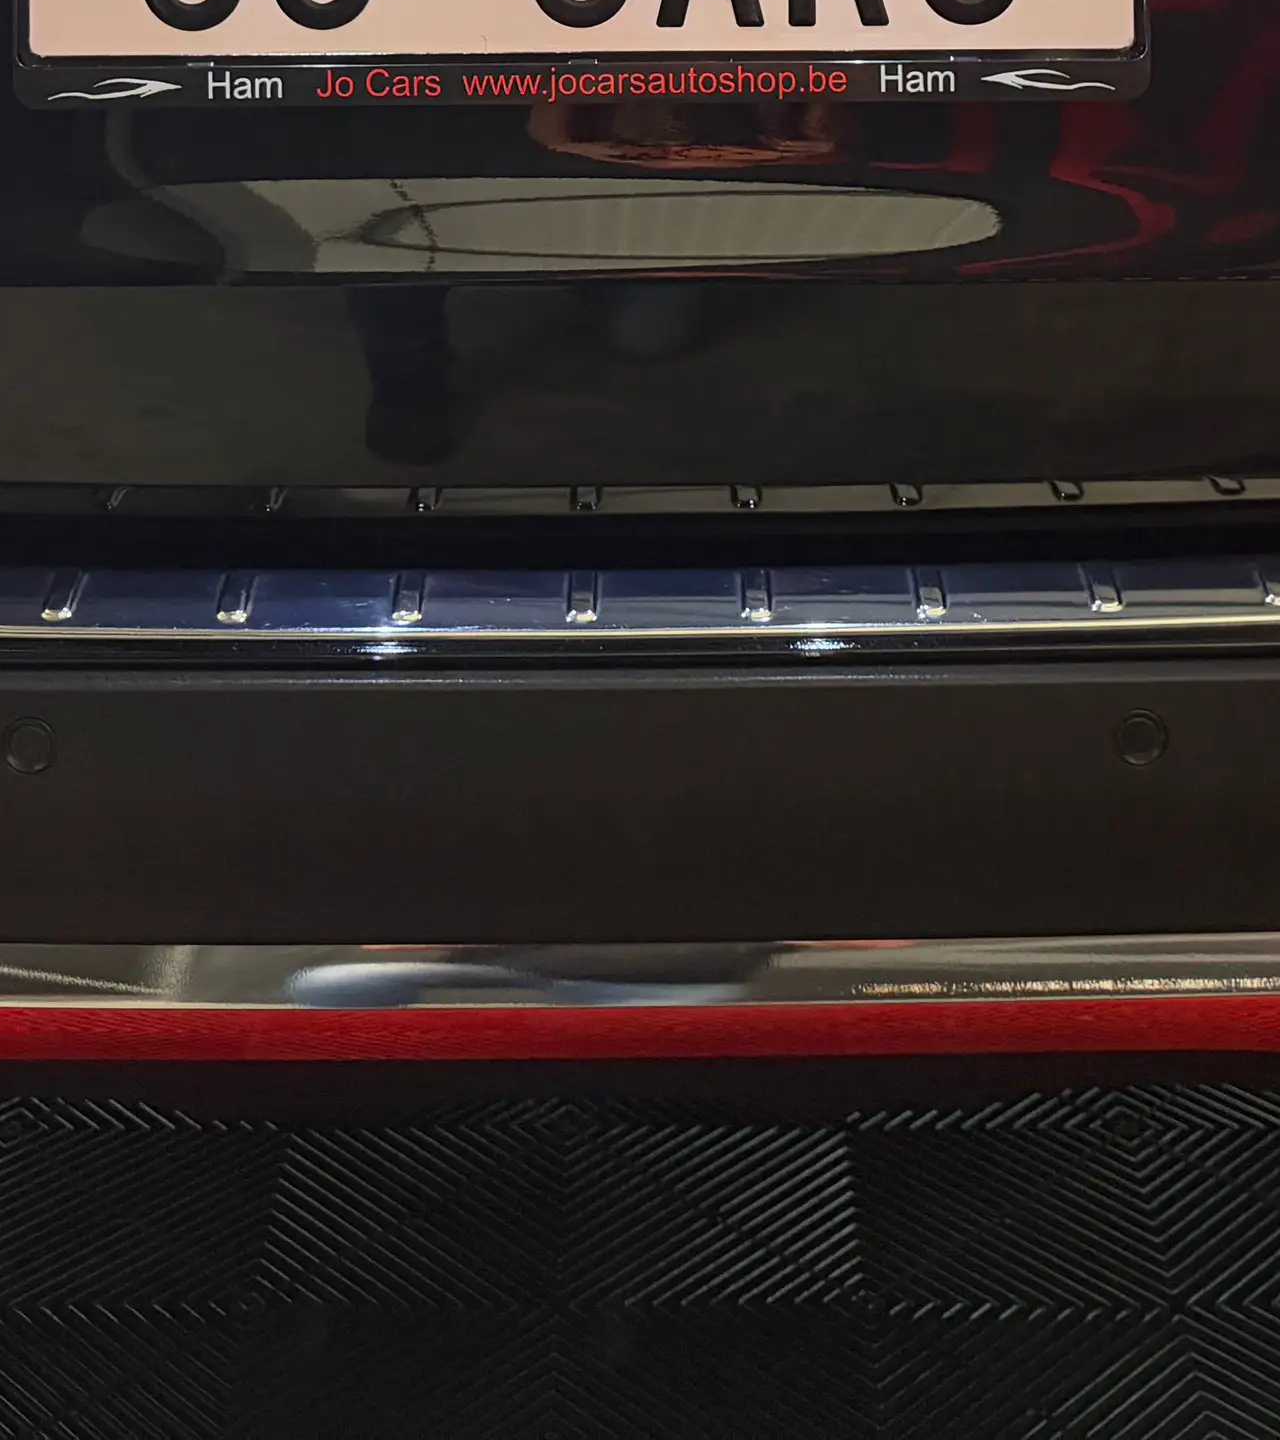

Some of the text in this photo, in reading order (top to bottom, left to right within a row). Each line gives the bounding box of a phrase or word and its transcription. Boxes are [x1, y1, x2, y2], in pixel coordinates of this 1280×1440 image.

[207, 64, 955, 103] Ham Jo Cars www.jocarsautoshop.be Ham
